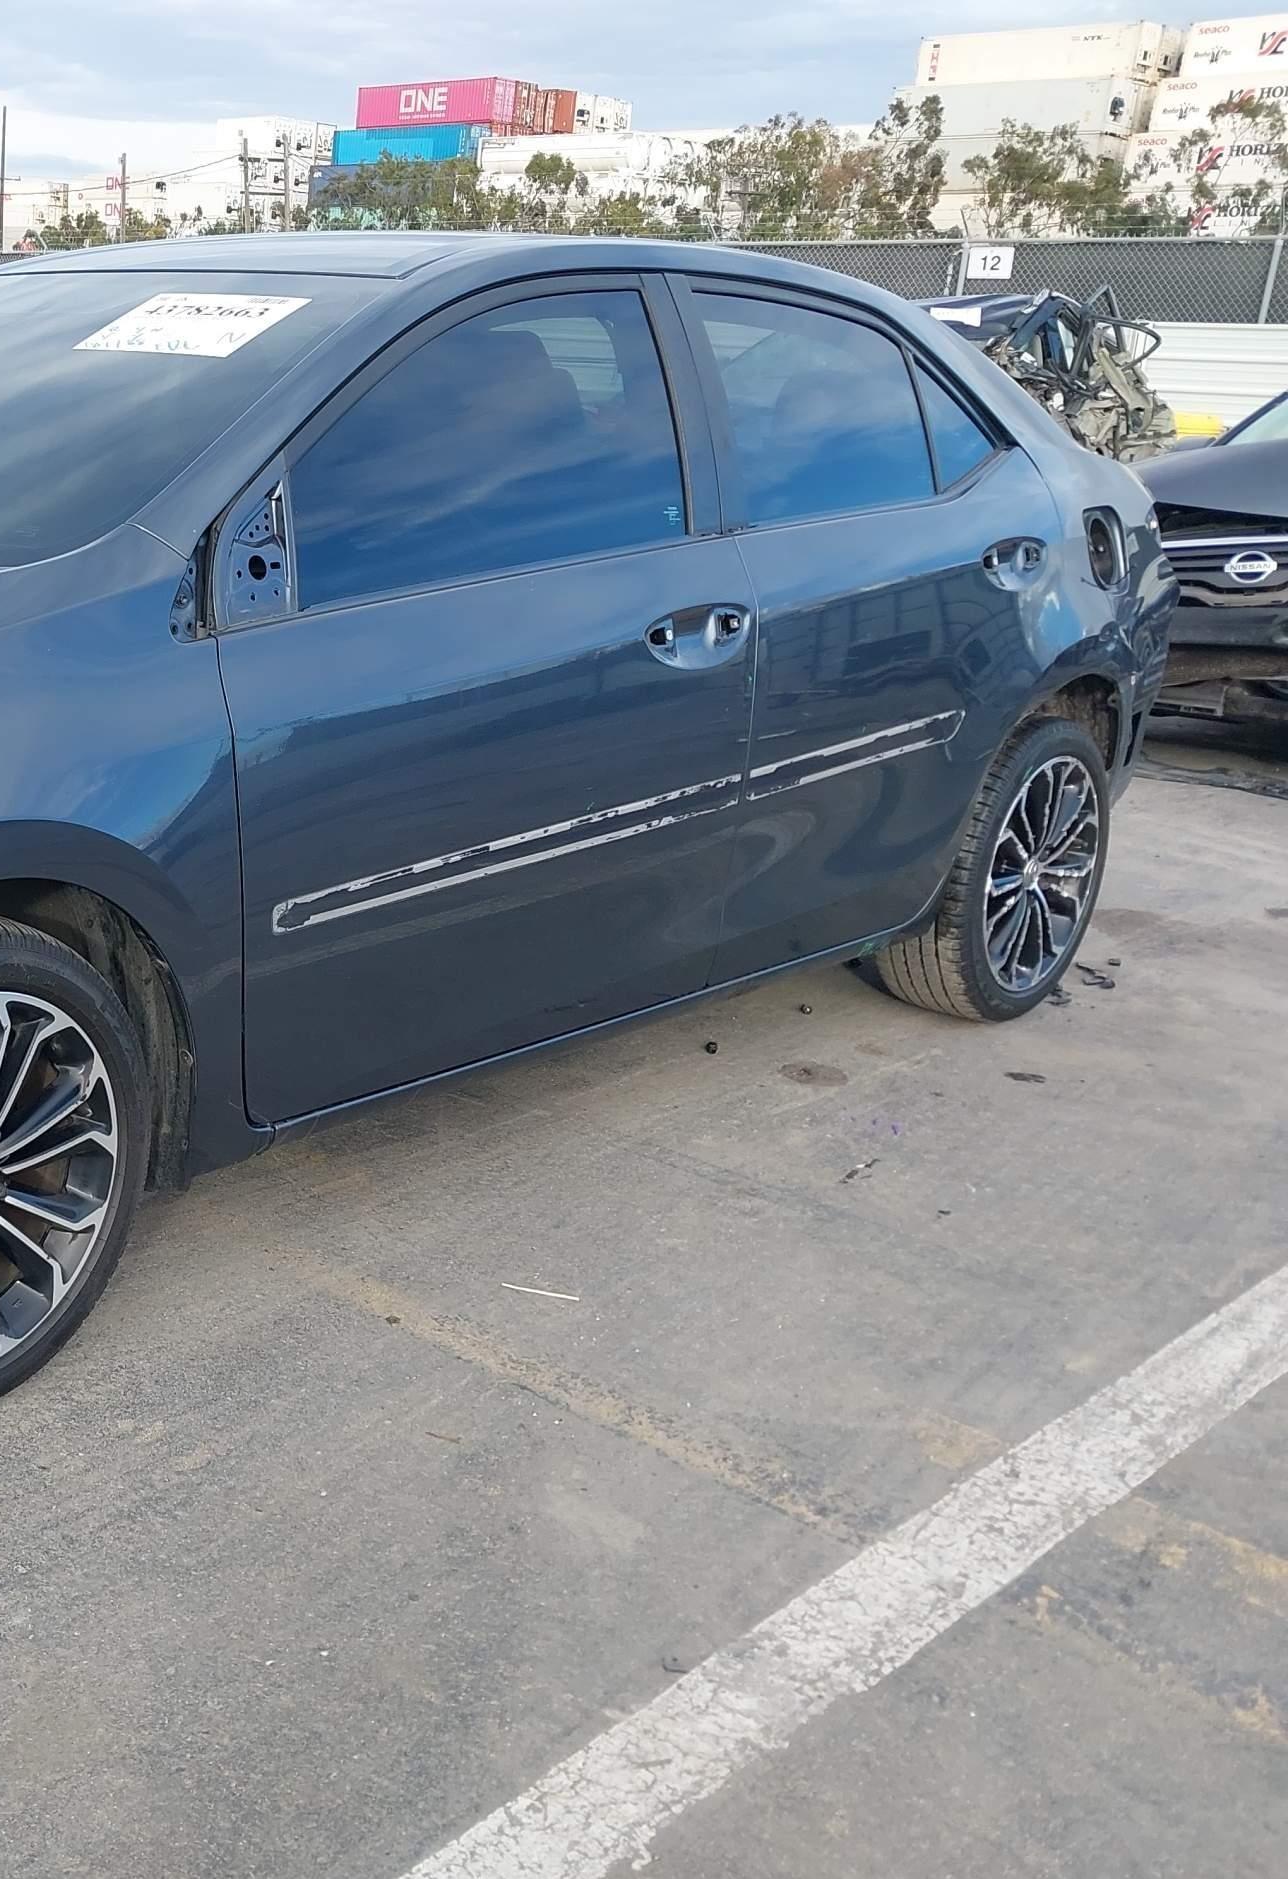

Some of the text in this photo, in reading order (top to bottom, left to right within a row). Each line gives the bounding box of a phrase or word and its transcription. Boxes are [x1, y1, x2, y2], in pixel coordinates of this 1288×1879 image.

[1199, 25, 1230, 35] seaco
[1167, 82, 1198, 91] seaco
[1259, 86, 1288, 98] HO
[400, 87, 449, 113] ONE
[1137, 138, 1168, 146] seaco
[1228, 143, 1288, 157] HORIZ
[981, 256, 1001, 271] 12
[1230, 563, 1271, 571] NISSAN
